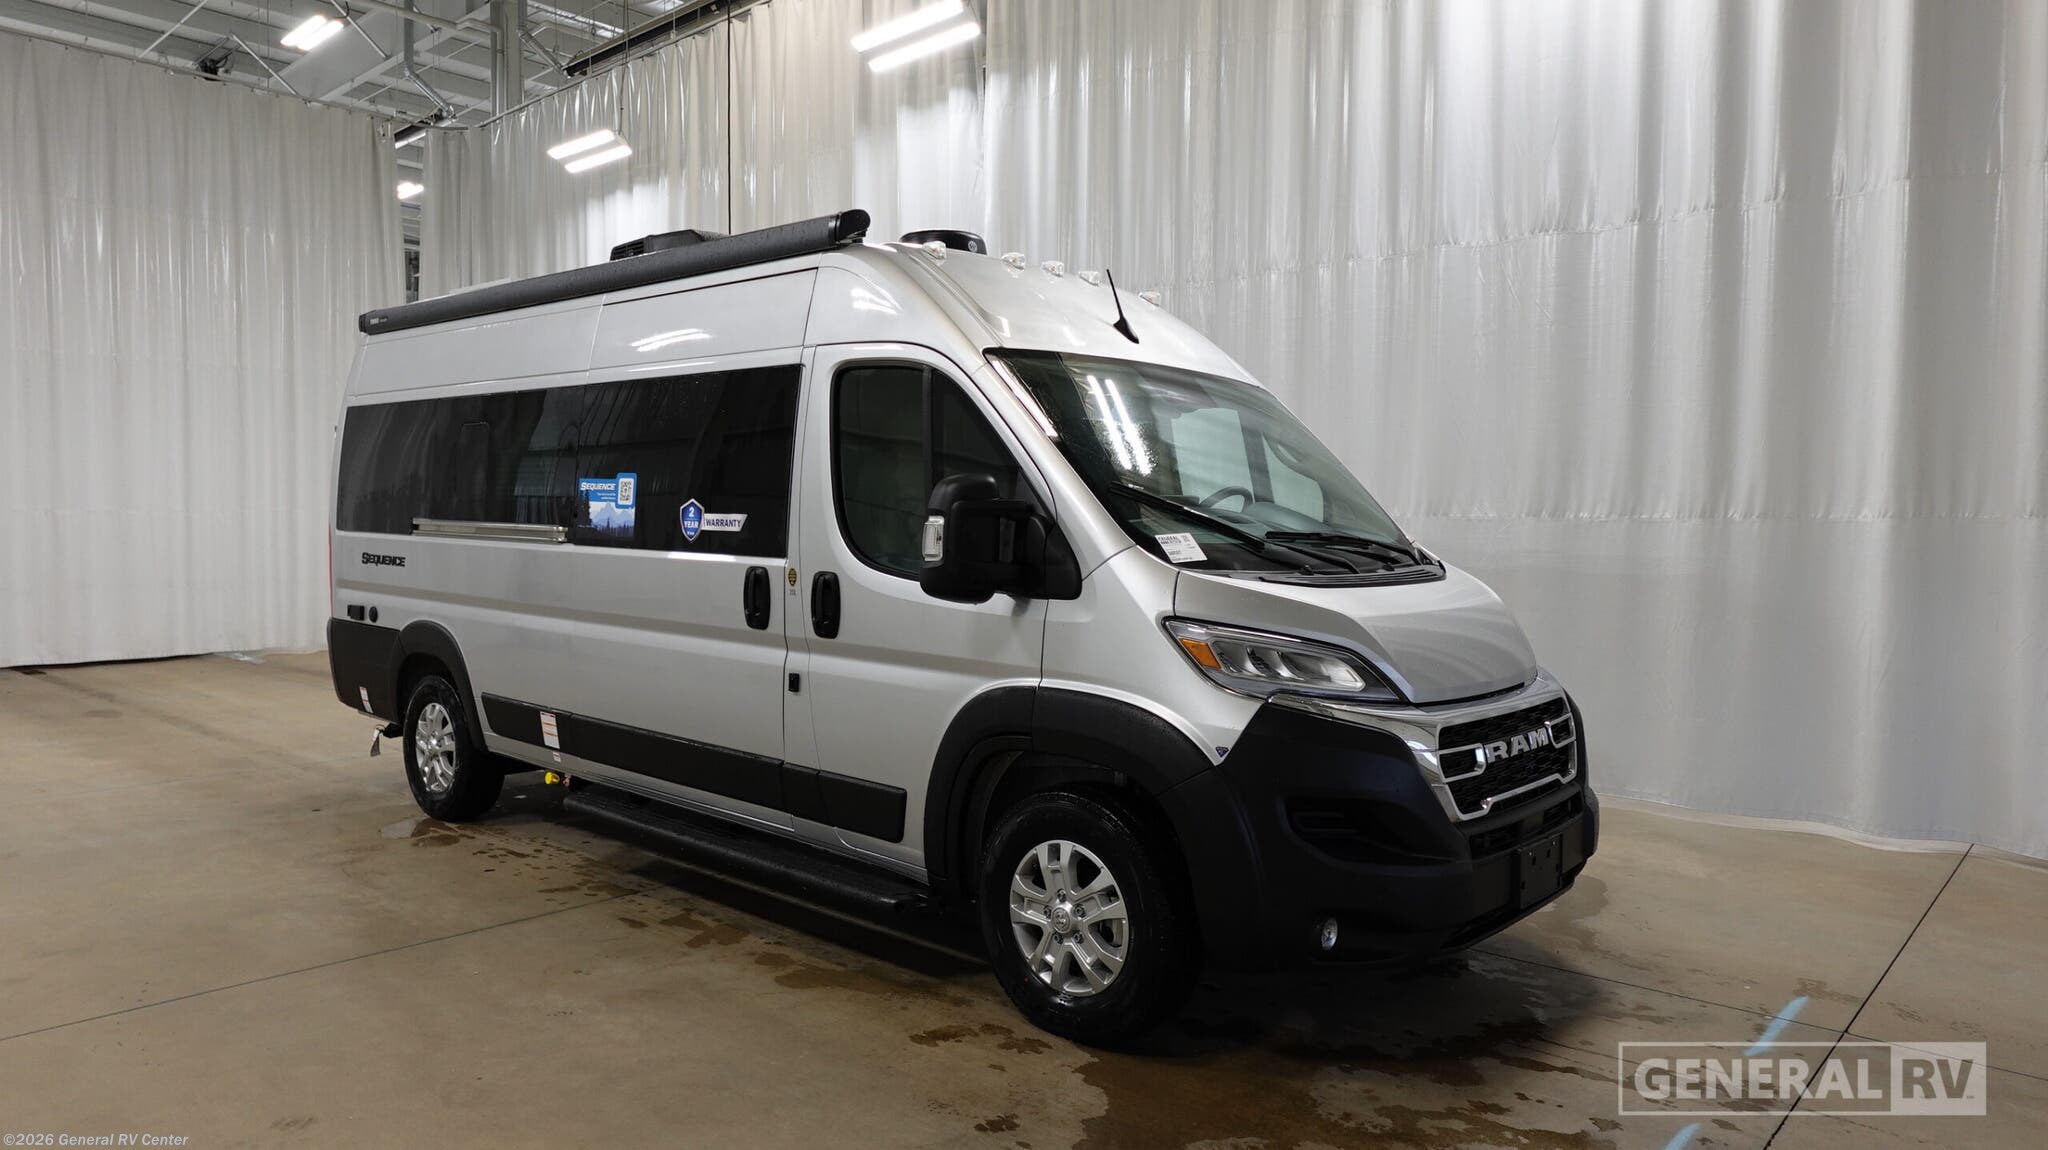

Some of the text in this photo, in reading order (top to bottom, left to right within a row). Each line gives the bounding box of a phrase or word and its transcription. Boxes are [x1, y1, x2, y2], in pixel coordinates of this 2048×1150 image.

[688, 506, 696, 518] 2
[684, 520, 700, 529] YEAR
[705, 518, 742, 528] WARRANTY
[361, 551, 407, 567] SEQUENCE
[1484, 726, 1550, 764] RAM
